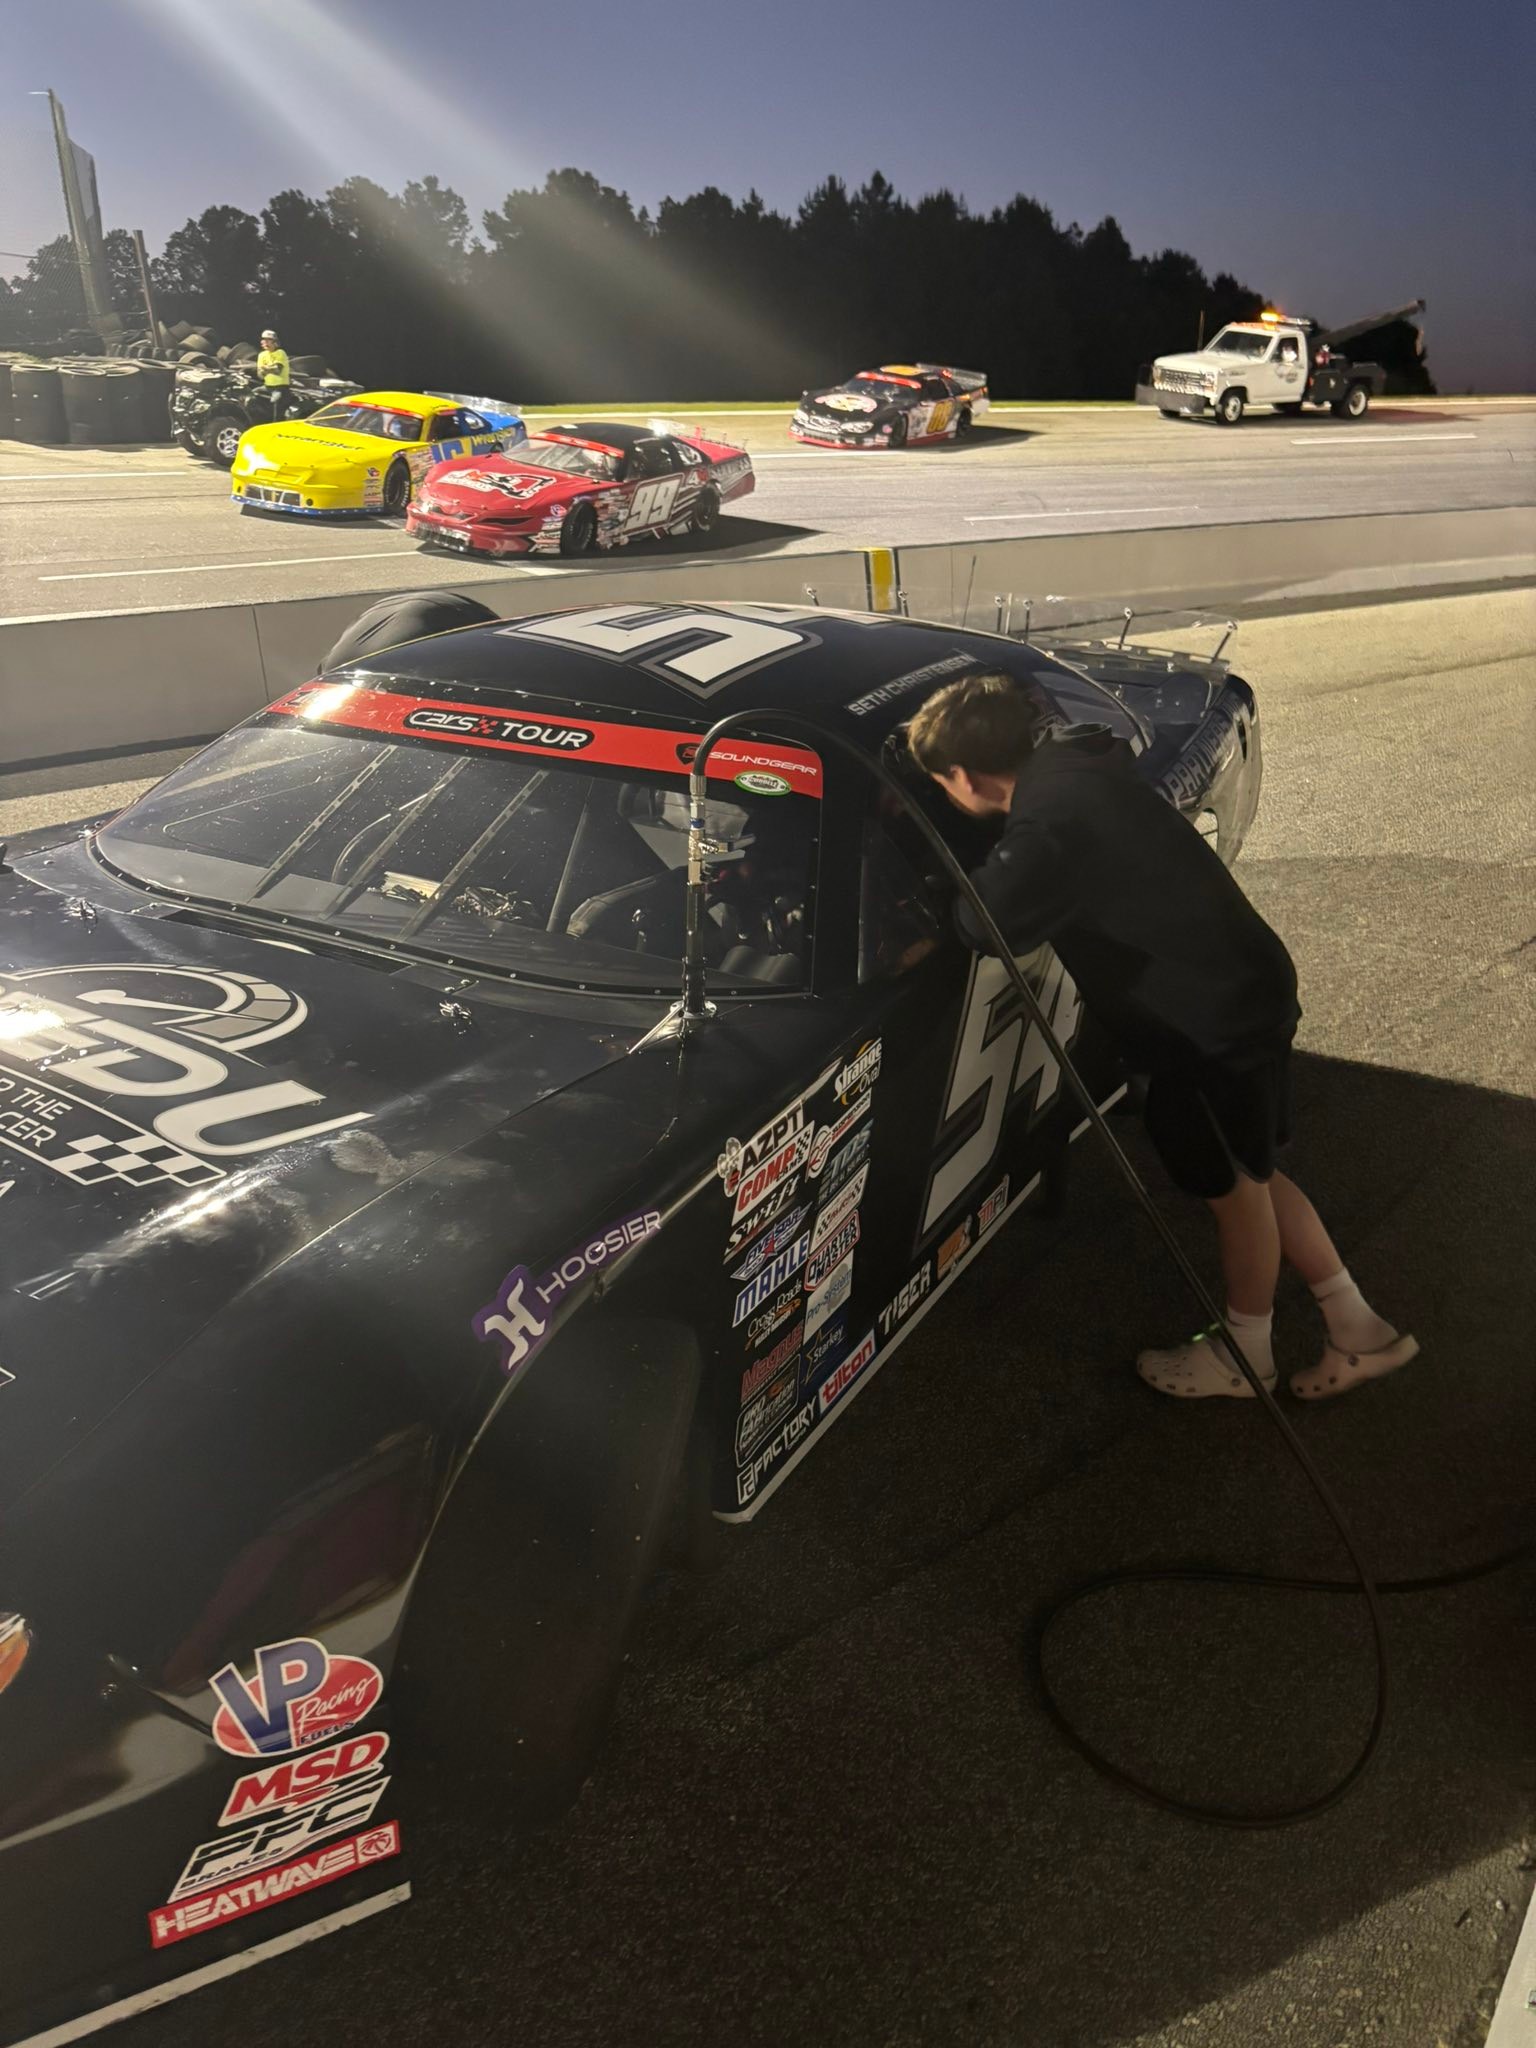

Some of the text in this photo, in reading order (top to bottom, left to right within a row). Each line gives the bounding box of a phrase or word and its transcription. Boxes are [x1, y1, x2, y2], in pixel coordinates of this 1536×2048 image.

[625, 478, 682, 532] 99
[847, 689, 893, 717] SETH
[501, 721, 588, 748] TOUR
[708, 751, 818, 776] SOUNDGEAR
[834, 1042, 883, 1098] Strange
[11, 1086, 73, 1121] THE
[742, 1102, 803, 1176] AZPT
[737, 1142, 796, 1212] COMP
[724, 1174, 801, 1256] Swift
[535, 1210, 662, 1304] HOOSIER
[734, 1233, 809, 1328] MAHLE
[815, 1227, 858, 1284] MASTER
[813, 1324, 845, 1362] Starkey
[822, 1339, 873, 1404] tilton
[754, 1396, 817, 1486] FACTORY
[210, 1637, 329, 1754] VP
[297, 1673, 380, 1732] Racing
[299, 1719, 357, 1746] FUELS
[226, 1737, 382, 1819] MSD
[185, 1783, 381, 1879] PFC
[156, 1841, 357, 1938] HEATWAVE
[181, 1845, 283, 1889] BRAKES
